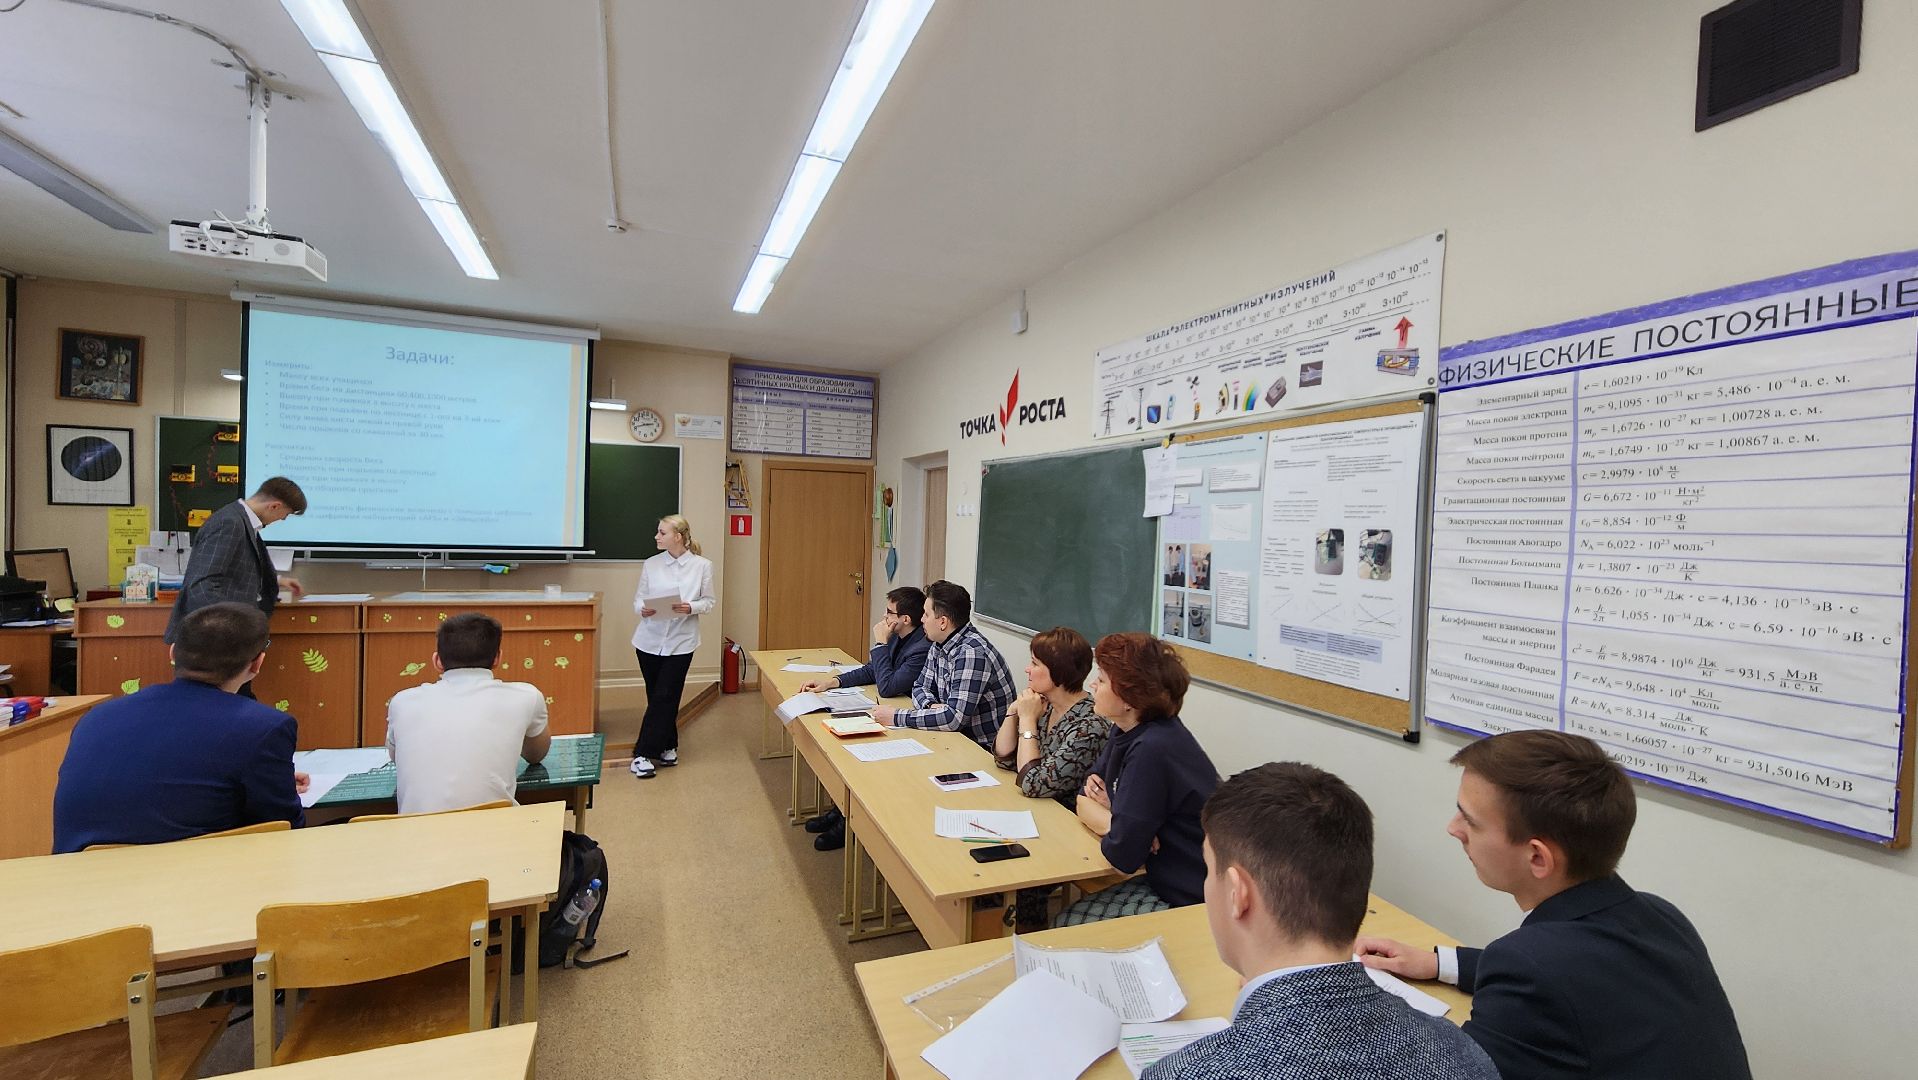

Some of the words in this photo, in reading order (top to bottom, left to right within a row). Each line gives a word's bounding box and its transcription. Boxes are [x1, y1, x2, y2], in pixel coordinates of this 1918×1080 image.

[1146, 329, 1170, 342] ШКАЛА
[1174, 296, 1264, 334] ЭЛЕКТРОМАГНИТНЫХ
[1270, 269, 1336, 301] ИЗЛУЧЕНИЙ
[1438, 335, 1615, 387] ФИЗИЧЕСКИЕ
[1633, 277, 1918, 353] ПОСТОЯННЫЕ
[385, 346, 456, 367] Задачи:
[1686, 366, 1703, 376] Кл
[960, 413, 996, 439] ТОЧКА
[1019, 397, 1066, 426] РОСТА
[1521, 409, 1567, 421] электрона
[1529, 432, 1568, 443] протона
[1457, 477, 1495, 486] Скорость
[1518, 538, 1562, 548] Авогадро
[1523, 580, 1559, 591] Планка
[1500, 623, 1556, 636] взаимосвязи
[1517, 662, 1556, 676] Фарадея
